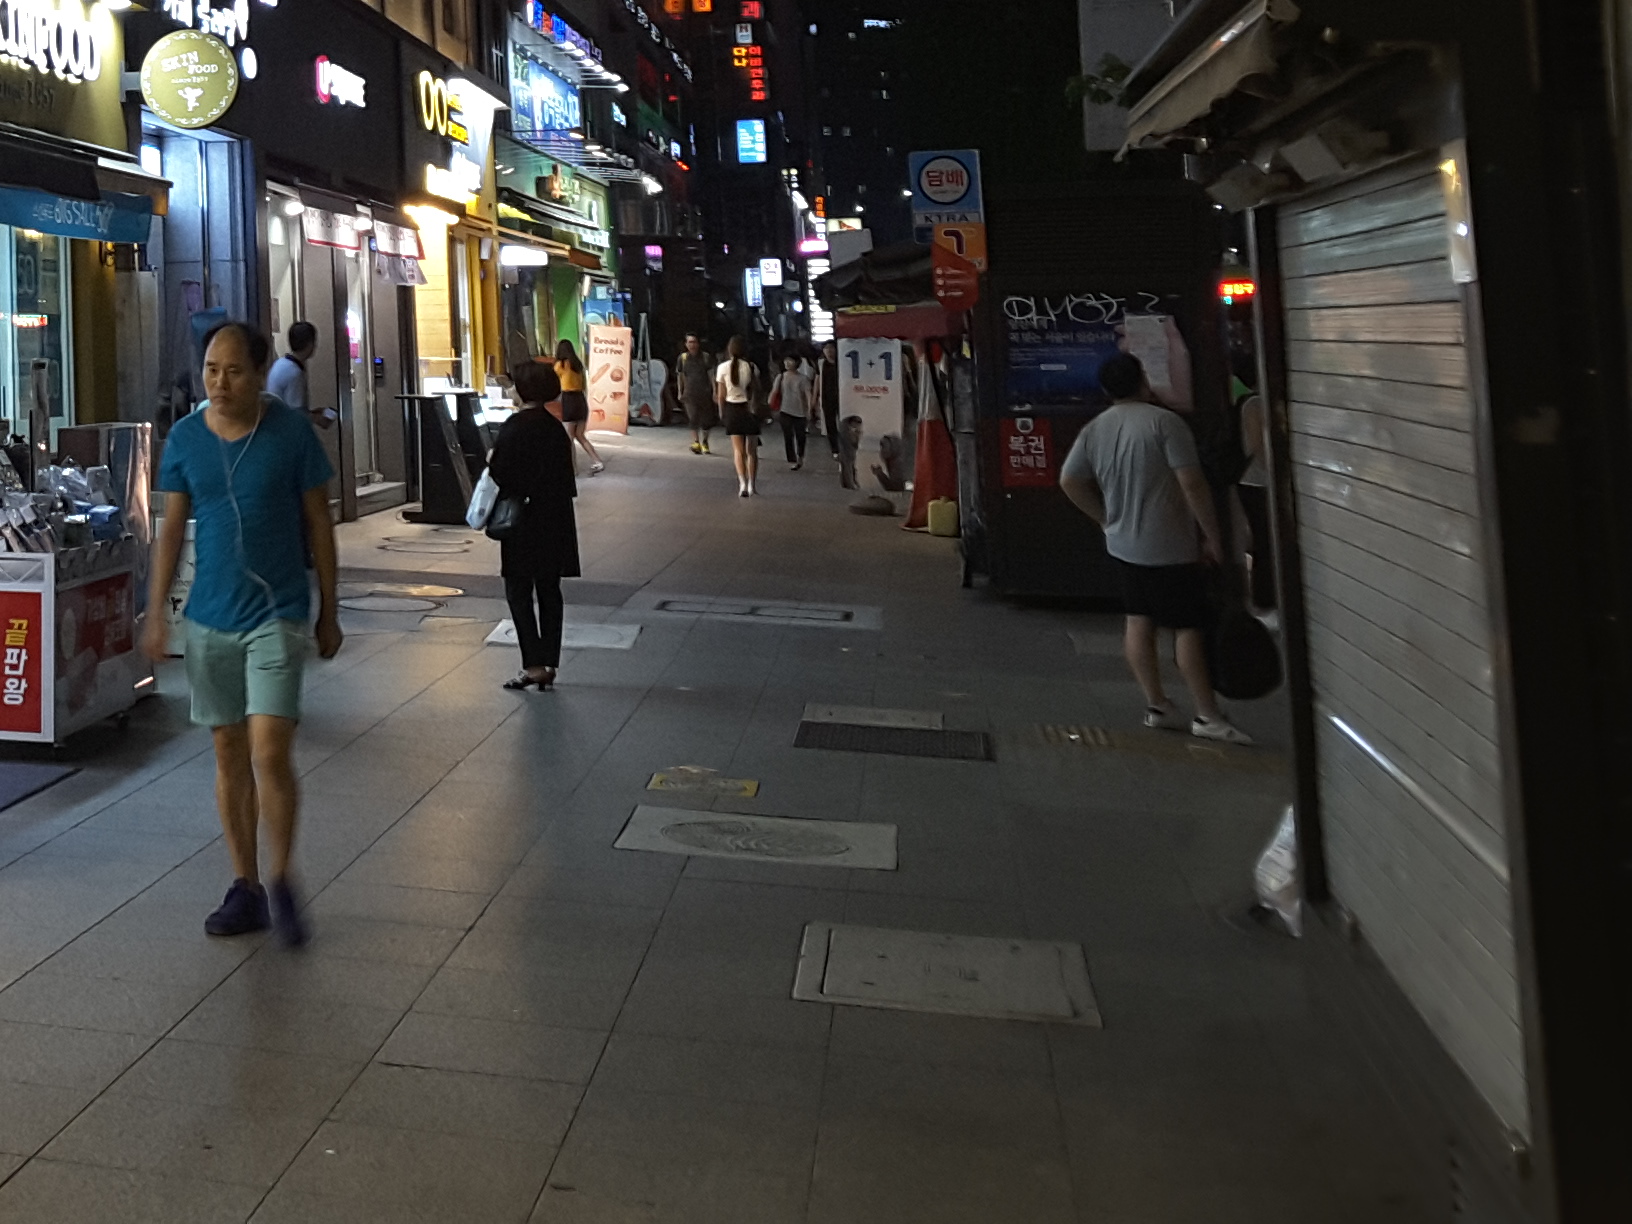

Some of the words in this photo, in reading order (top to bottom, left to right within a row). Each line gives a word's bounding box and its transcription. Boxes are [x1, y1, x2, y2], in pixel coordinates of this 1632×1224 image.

[160, 51, 199, 73] SKIN
[187, 63, 219, 75] FOOD
[926, 169, 965, 187] 담배
[593, 336, 619, 346] Bread
[593, 347, 624, 356] Coffee
[844, 349, 894, 381] 1+1
[1008, 434, 1046, 455] 복권
[2, 618, 29, 706] 끝판왕
